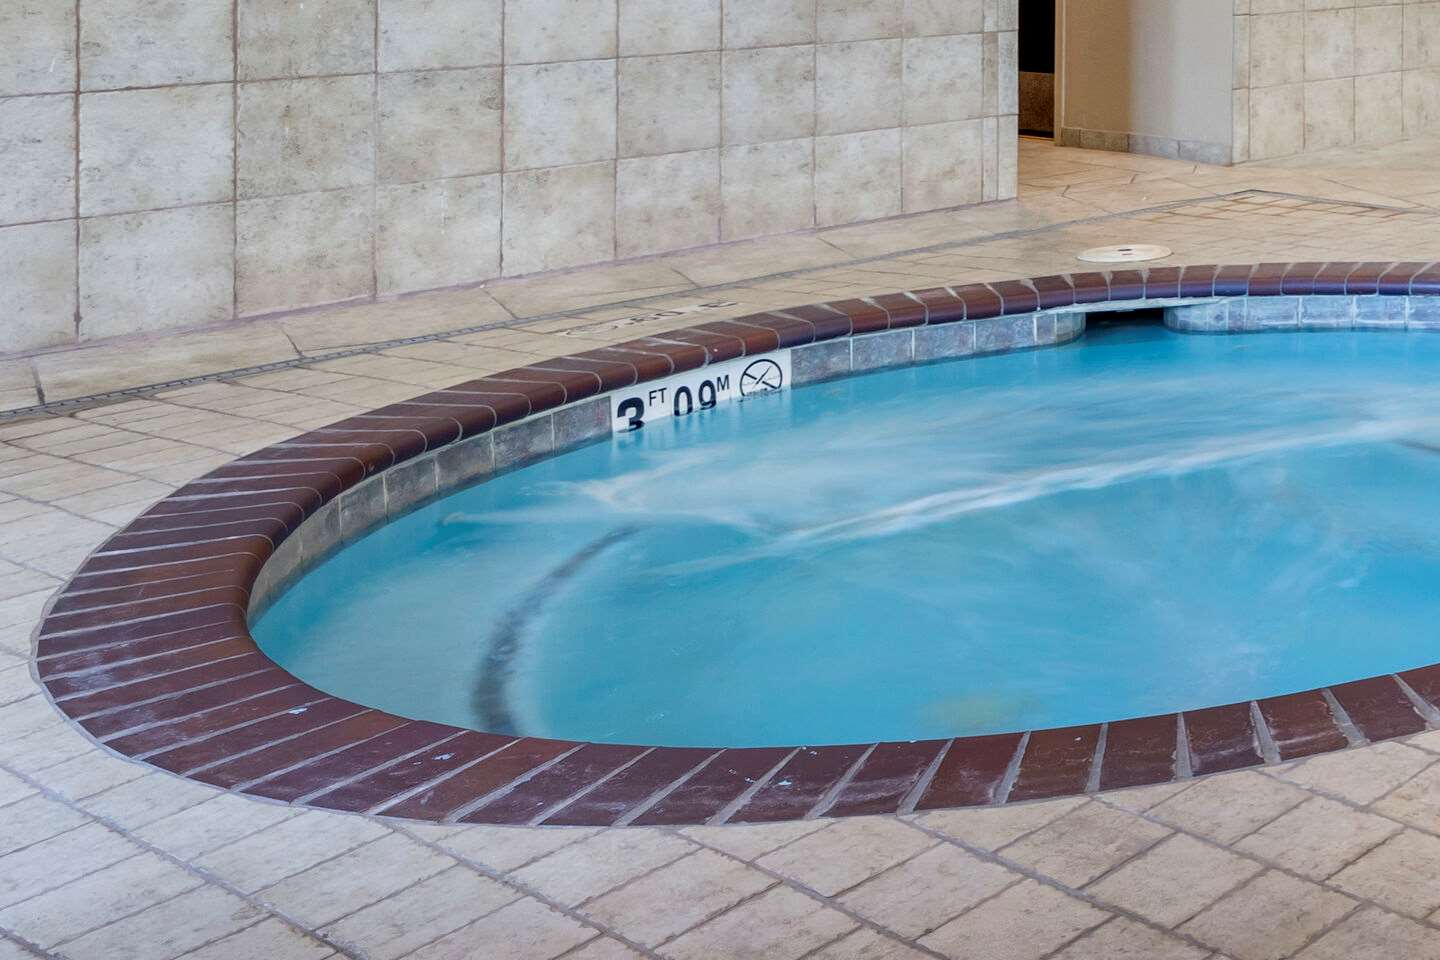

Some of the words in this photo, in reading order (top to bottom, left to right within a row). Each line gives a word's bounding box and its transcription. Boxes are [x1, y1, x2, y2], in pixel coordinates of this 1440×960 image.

[617, 397, 645, 433] 3
[649, 387, 668, 407] FT
[716, 374, 730, 393] M
